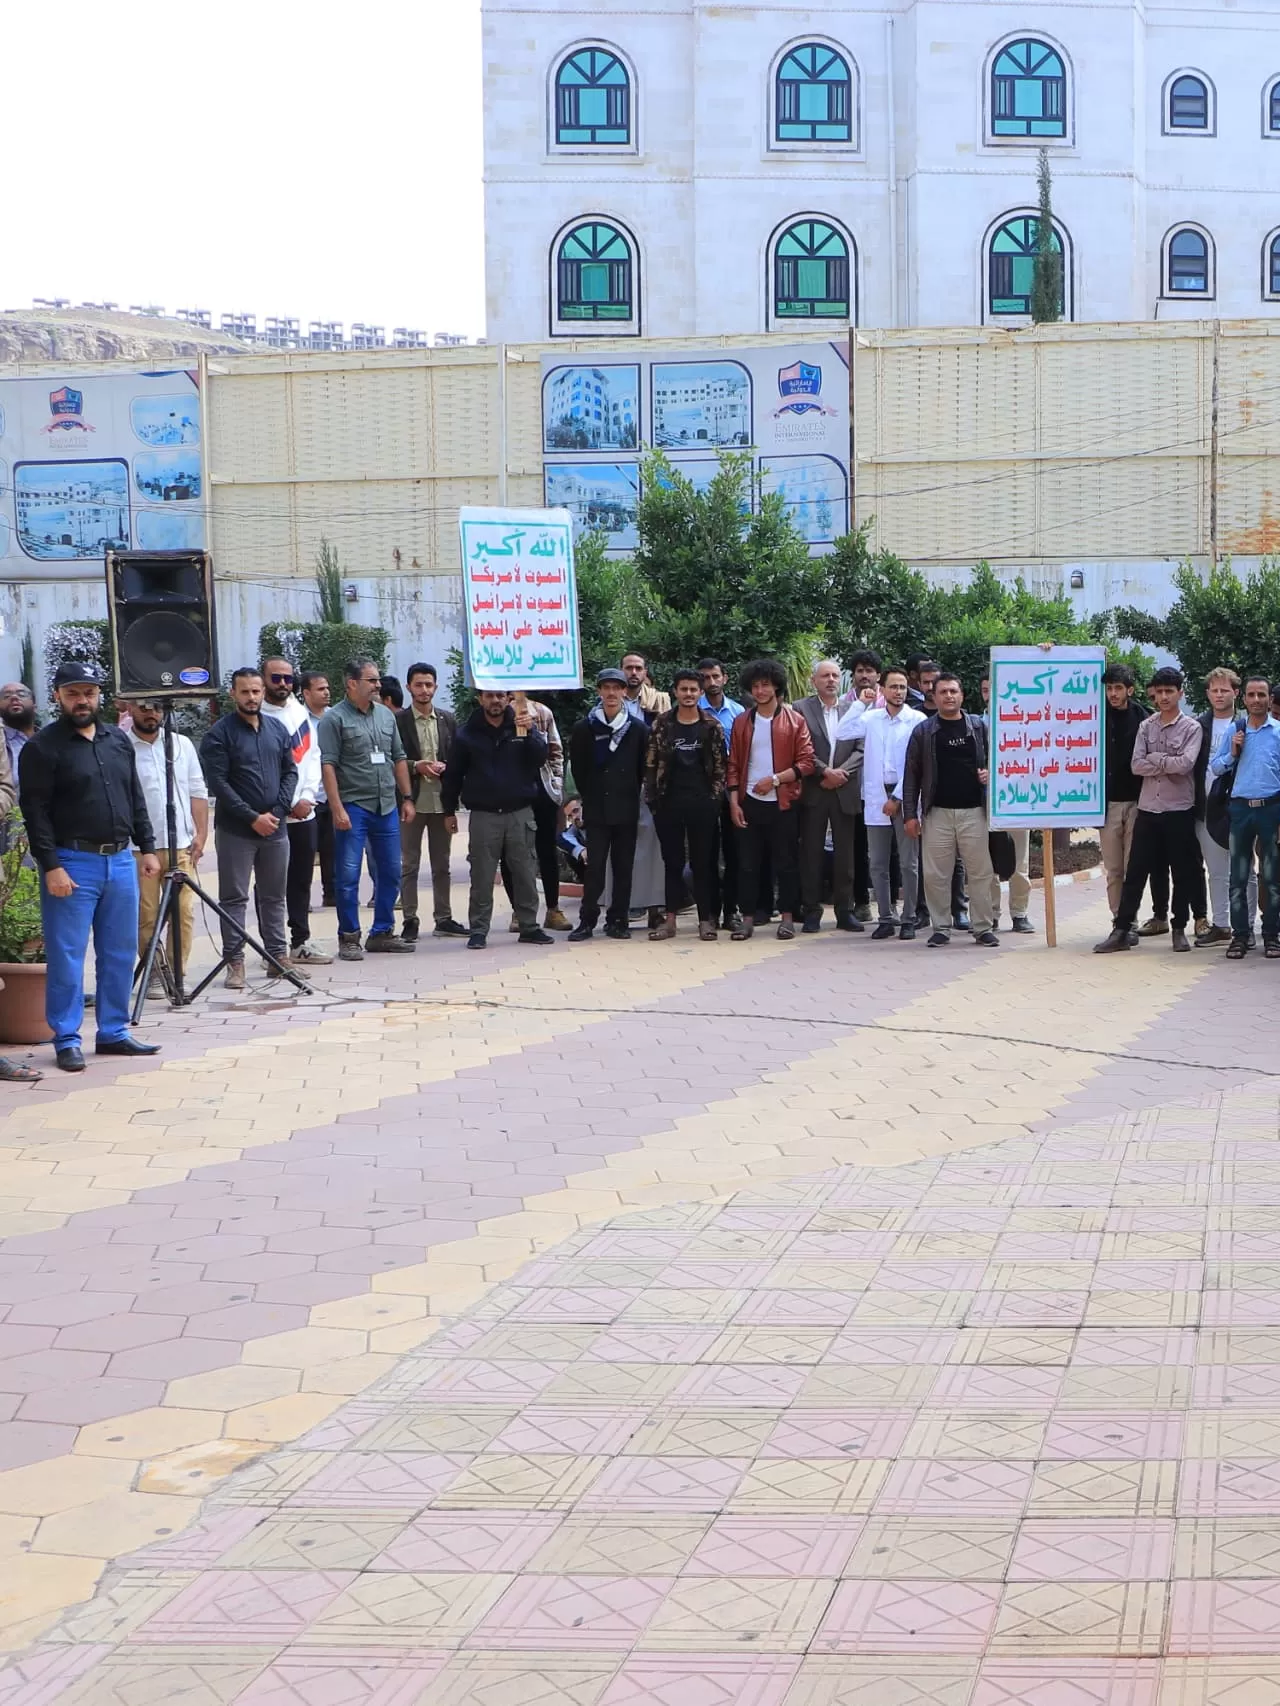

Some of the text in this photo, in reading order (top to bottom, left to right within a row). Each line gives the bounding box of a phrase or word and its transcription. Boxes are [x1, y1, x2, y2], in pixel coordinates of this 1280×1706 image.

[774, 421, 826, 432] EMIRATES
[470, 528, 564, 563] الله أكبر
[470, 563, 566, 586] الموت لأمريكا
[472, 591, 567, 614] الموت لإسرائيل
[473, 619, 568, 640] اللعنة على اليهود
[471, 641, 570, 672] النصر للإسلام
[999, 666, 1098, 703] الله أكبر
[999, 701, 1097, 726] الموت لأمريكا
[998, 730, 1097, 752] الموت لإسرائيل
[998, 756, 1097, 779] اللعنة على اليهود
[998, 779, 1097, 810] النصر للإسلام
